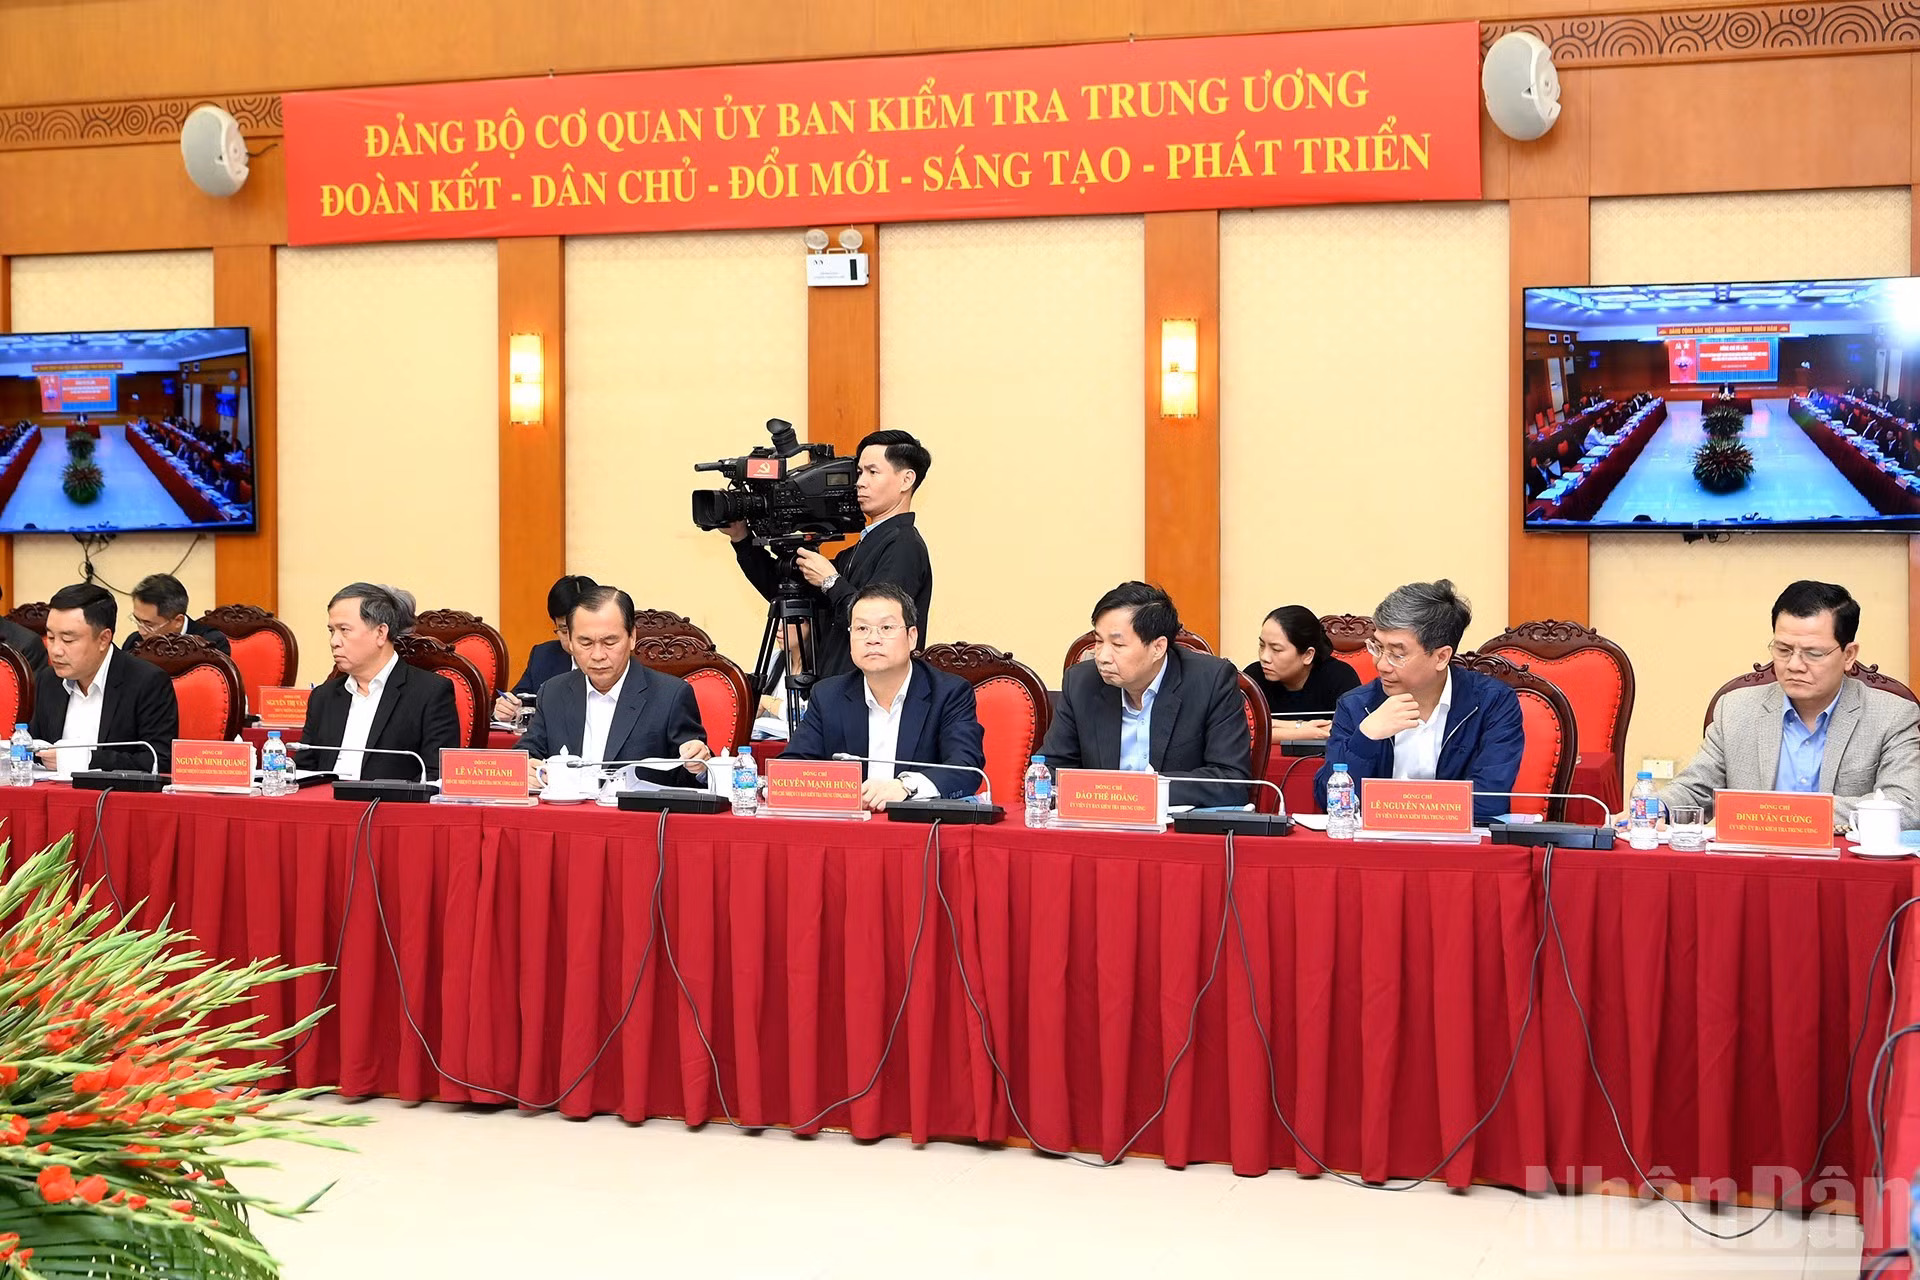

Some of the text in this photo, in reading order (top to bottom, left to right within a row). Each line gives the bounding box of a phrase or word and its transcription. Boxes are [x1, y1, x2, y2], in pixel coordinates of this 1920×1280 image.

[366, 67, 1370, 159] ĐẢNG BỘ CƠ QUAN ỦY BAN KIỂM TRA TRUNG ƯƠNG
[321, 116, 1431, 217] ĐOÀN KẾT - DÂN CHỦ - ĐỔI MỚI - SÁNG TẠO - PHÁT TRIỂN
[175, 756, 247, 767] NGUYỄN MINH QUANG
[455, 765, 513, 777] LÊ VĂN THÀNH
[772, 777, 858, 790] NGUYỄN MẠNH HÙNG
[1075, 789, 1139, 802] ĐÀO THẾ HOÀNG
[1370, 799, 1381, 809] LÊ
[1419, 802, 1439, 811] NAM
[1440, 803, 1462, 812] NINH
[1736, 812, 1813, 824] ĐINH VĂN CƯỜNG
